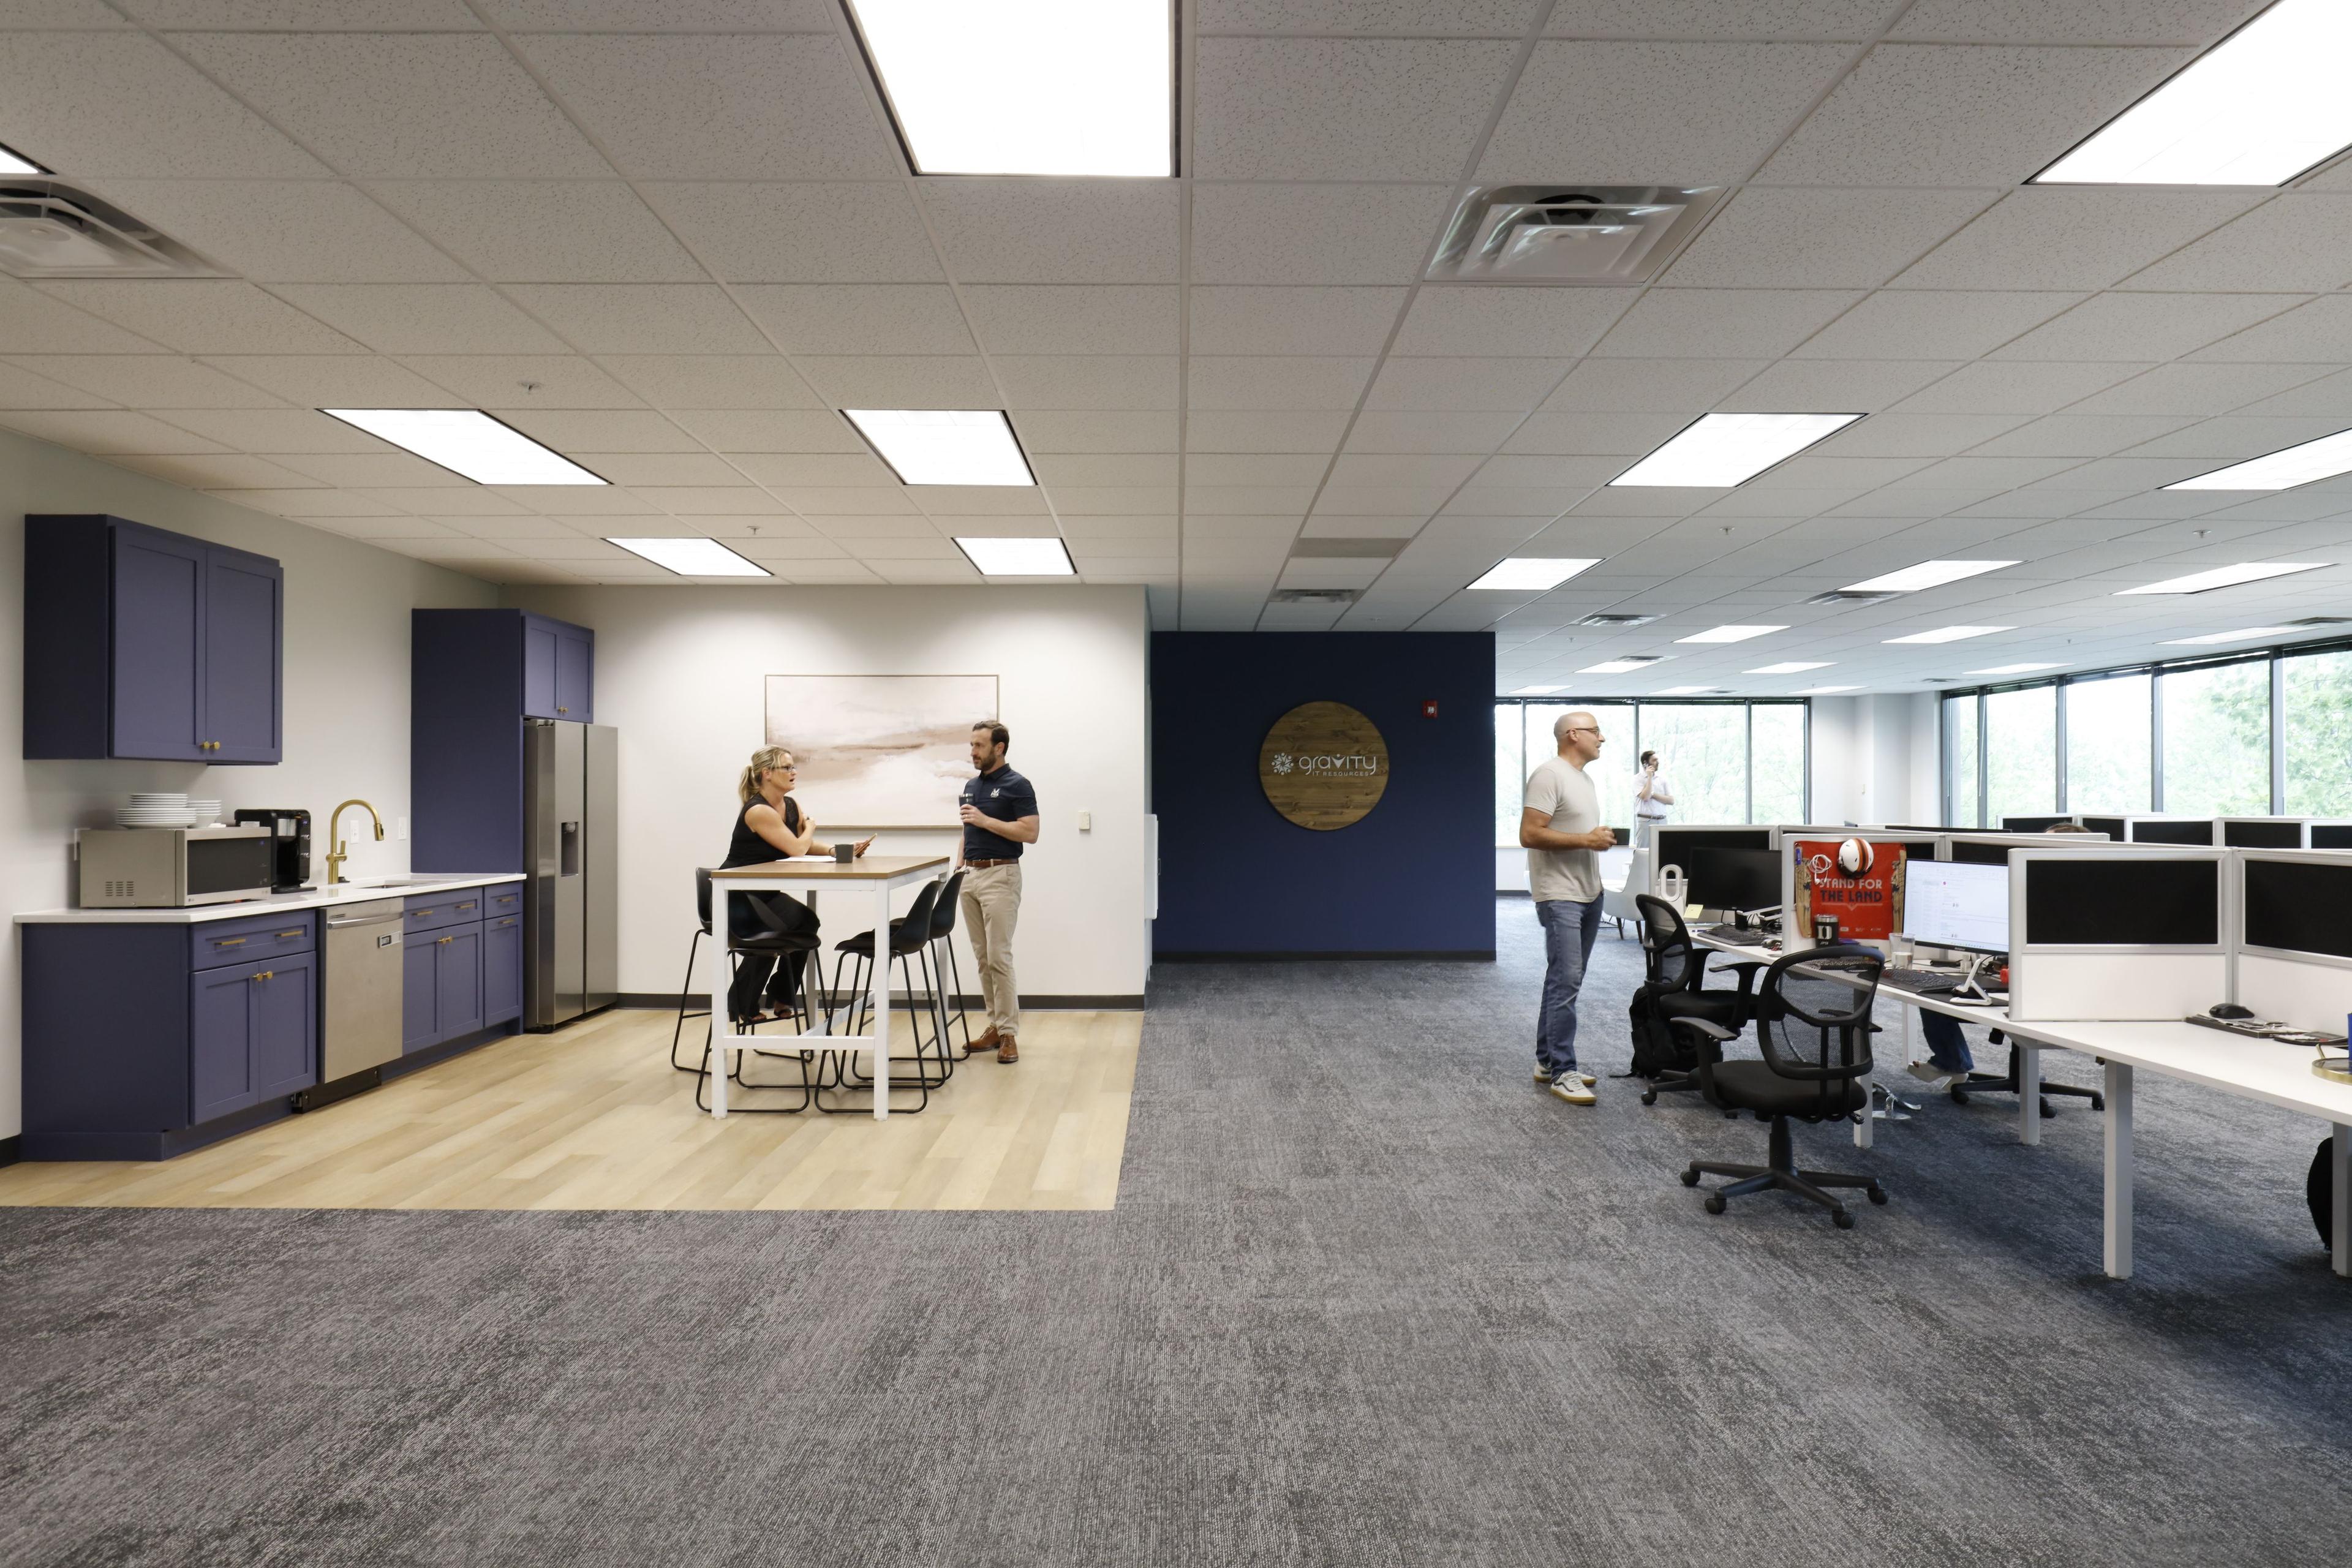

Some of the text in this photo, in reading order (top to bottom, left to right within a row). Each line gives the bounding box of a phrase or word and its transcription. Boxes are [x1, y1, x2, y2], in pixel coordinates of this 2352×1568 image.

[1299, 754, 1376, 775] gravity
[1819, 878, 1882, 889] STAND FOR
[1820, 890, 1882, 902] THE LAND
